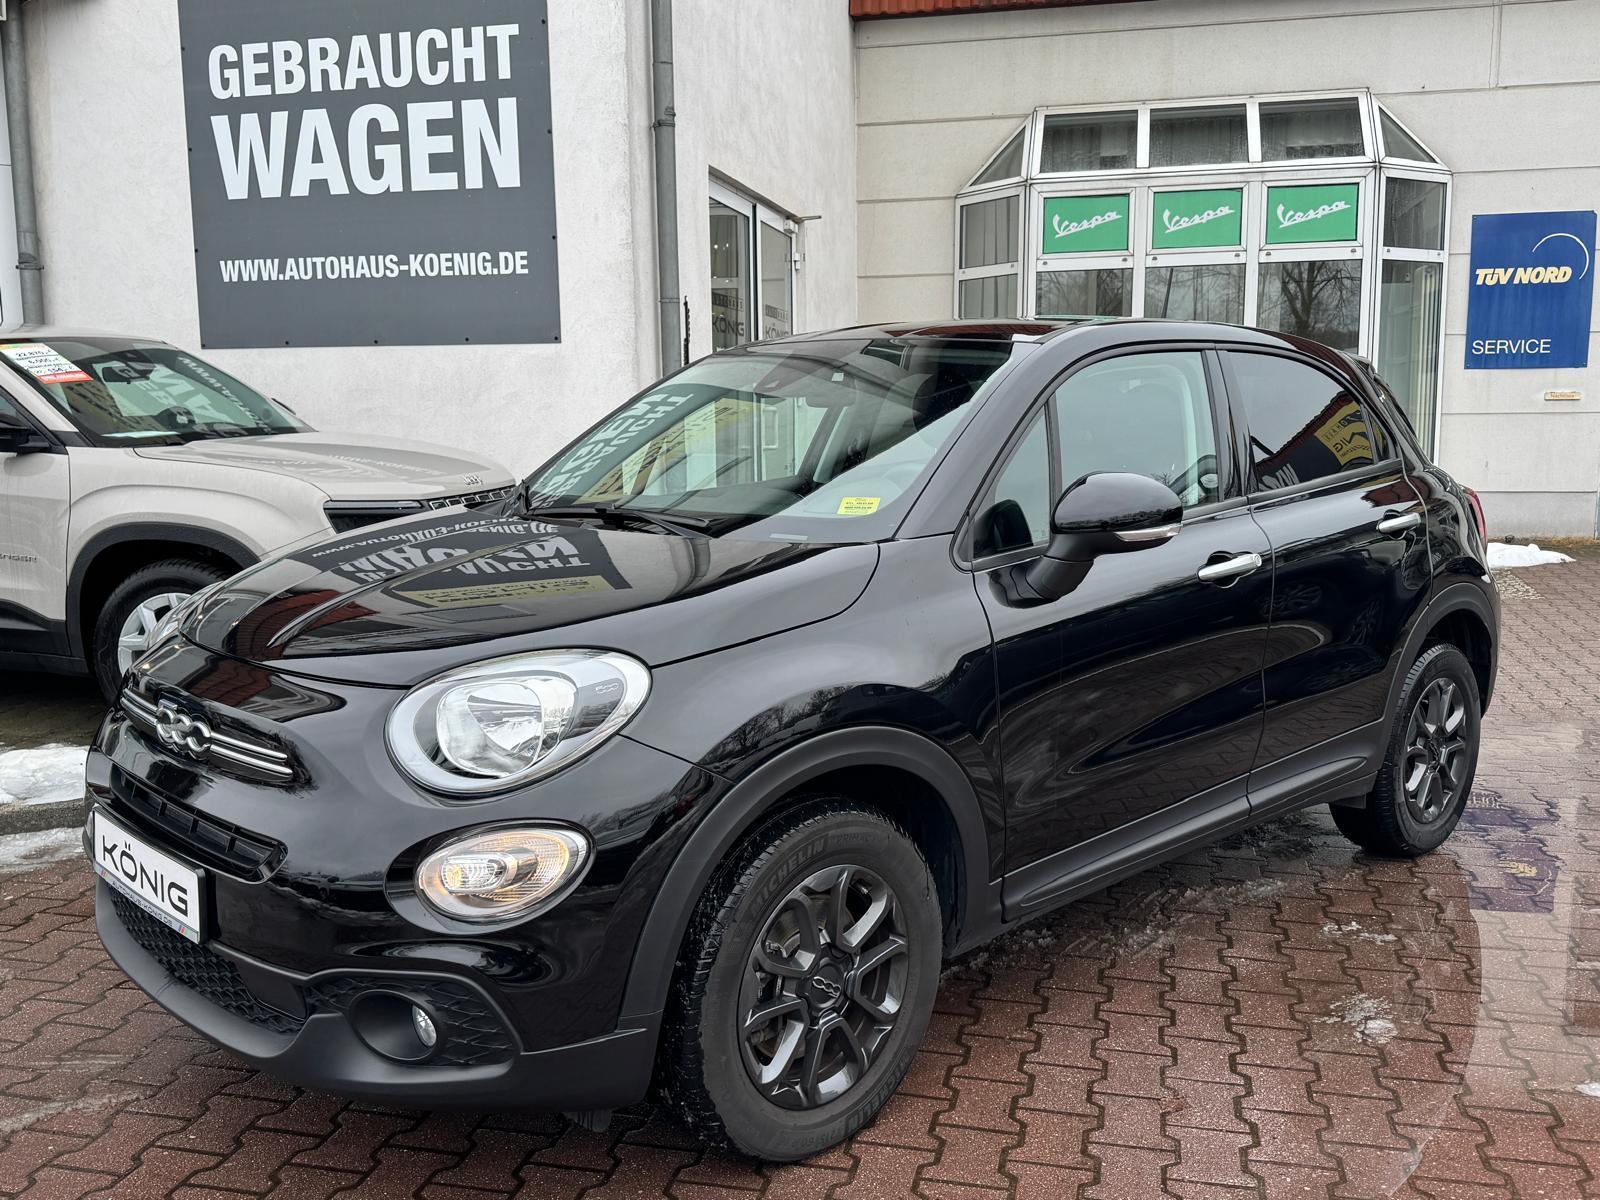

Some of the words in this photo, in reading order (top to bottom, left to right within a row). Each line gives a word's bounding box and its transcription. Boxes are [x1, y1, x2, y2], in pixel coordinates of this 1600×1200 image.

[208, 23, 520, 100] GEBRAUCHT
[210, 97, 521, 200] WAGEN
[1052, 210, 1123, 239] Vespa
[1163, 205, 1235, 234] Vespa
[1277, 200, 1351, 229] Vespa
[219, 251, 529, 283] WWW.AUTOHAUS-KOENIG.DE
[1475, 267, 1516, 286] TÜV
[1513, 266, 1573, 285] NORD
[1472, 339, 1551, 355] SERVICE
[102, 834, 189, 918] KÖNIG
